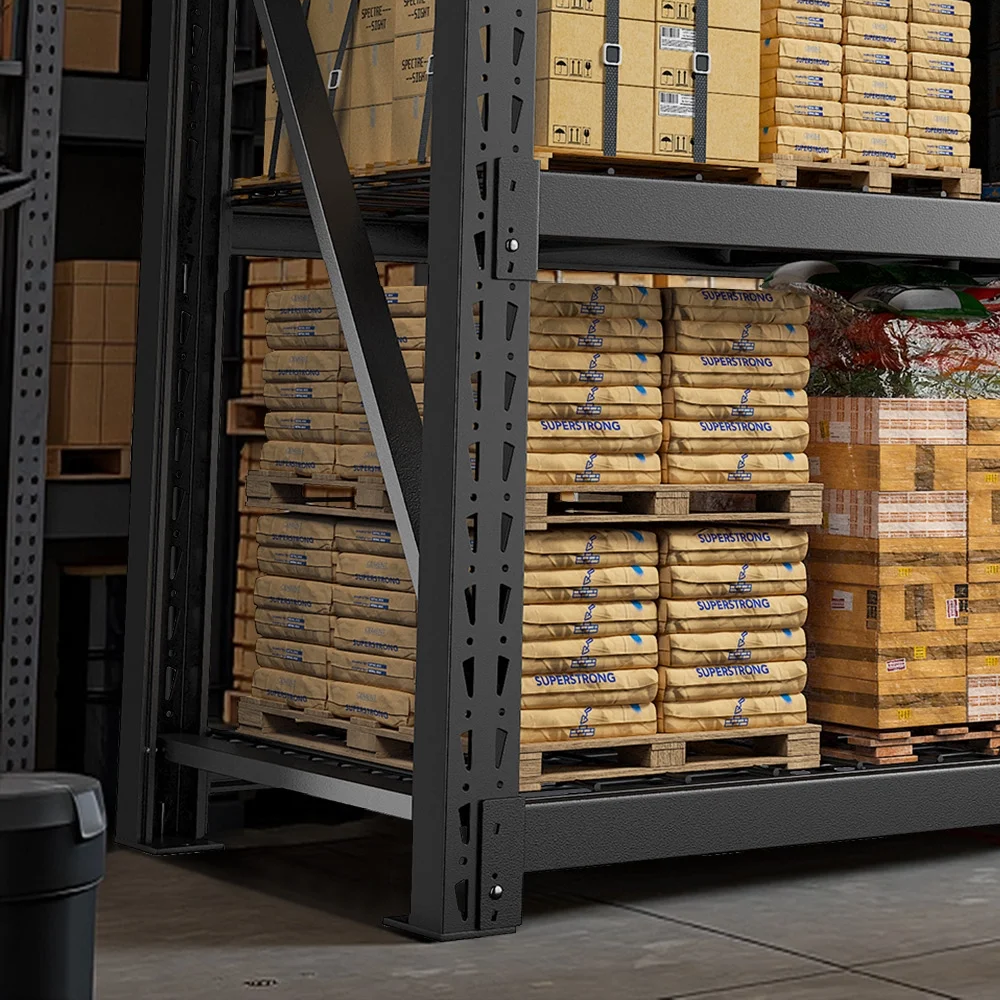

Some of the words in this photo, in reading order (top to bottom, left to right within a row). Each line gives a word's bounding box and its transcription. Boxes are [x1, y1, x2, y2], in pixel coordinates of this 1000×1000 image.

[702, 290, 774, 303] SUPERSTRONG
[701, 356, 773, 367] SUPERSTRONG
[540, 421, 621, 431] SUPERSTRONG
[699, 421, 773, 432] SUPERSTRONG
[698, 532, 771, 543] SUPERSTRONG
[696, 598, 771, 611] SUPERSTRONG
[695, 664, 769, 677] SUPERSTRONG
[534, 672, 616, 686] SUPERSTRONG
